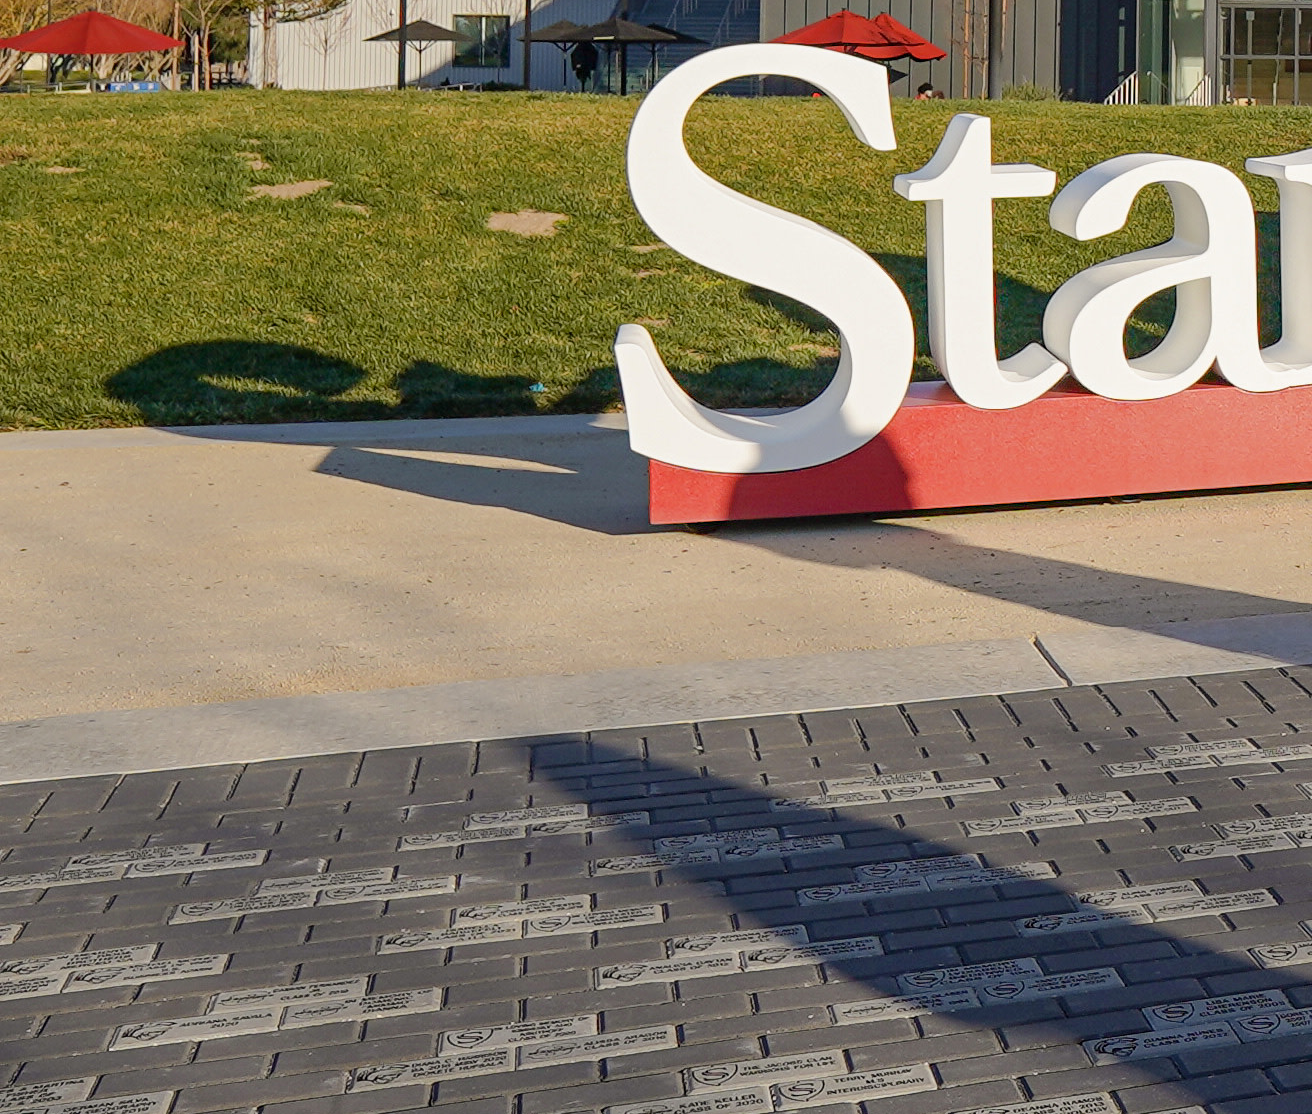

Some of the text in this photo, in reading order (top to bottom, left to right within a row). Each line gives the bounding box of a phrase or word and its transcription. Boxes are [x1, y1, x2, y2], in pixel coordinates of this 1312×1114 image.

[653, 966, 686, 974] CLASS
[1198, 1008, 1236, 1016] CLASS
[583, 1041, 618, 1050] CLASS
[1141, 1039, 1180, 1047] CLASS
[834, 1074, 866, 1083] TERRY
[826, 1077, 926, 1095] INTERDISCIPLINARY
[118, 1096, 151, 1104] SILVA
[714, 1094, 756, 1103] KELLER
[673, 1098, 764, 1114] CLASS OF 2020
